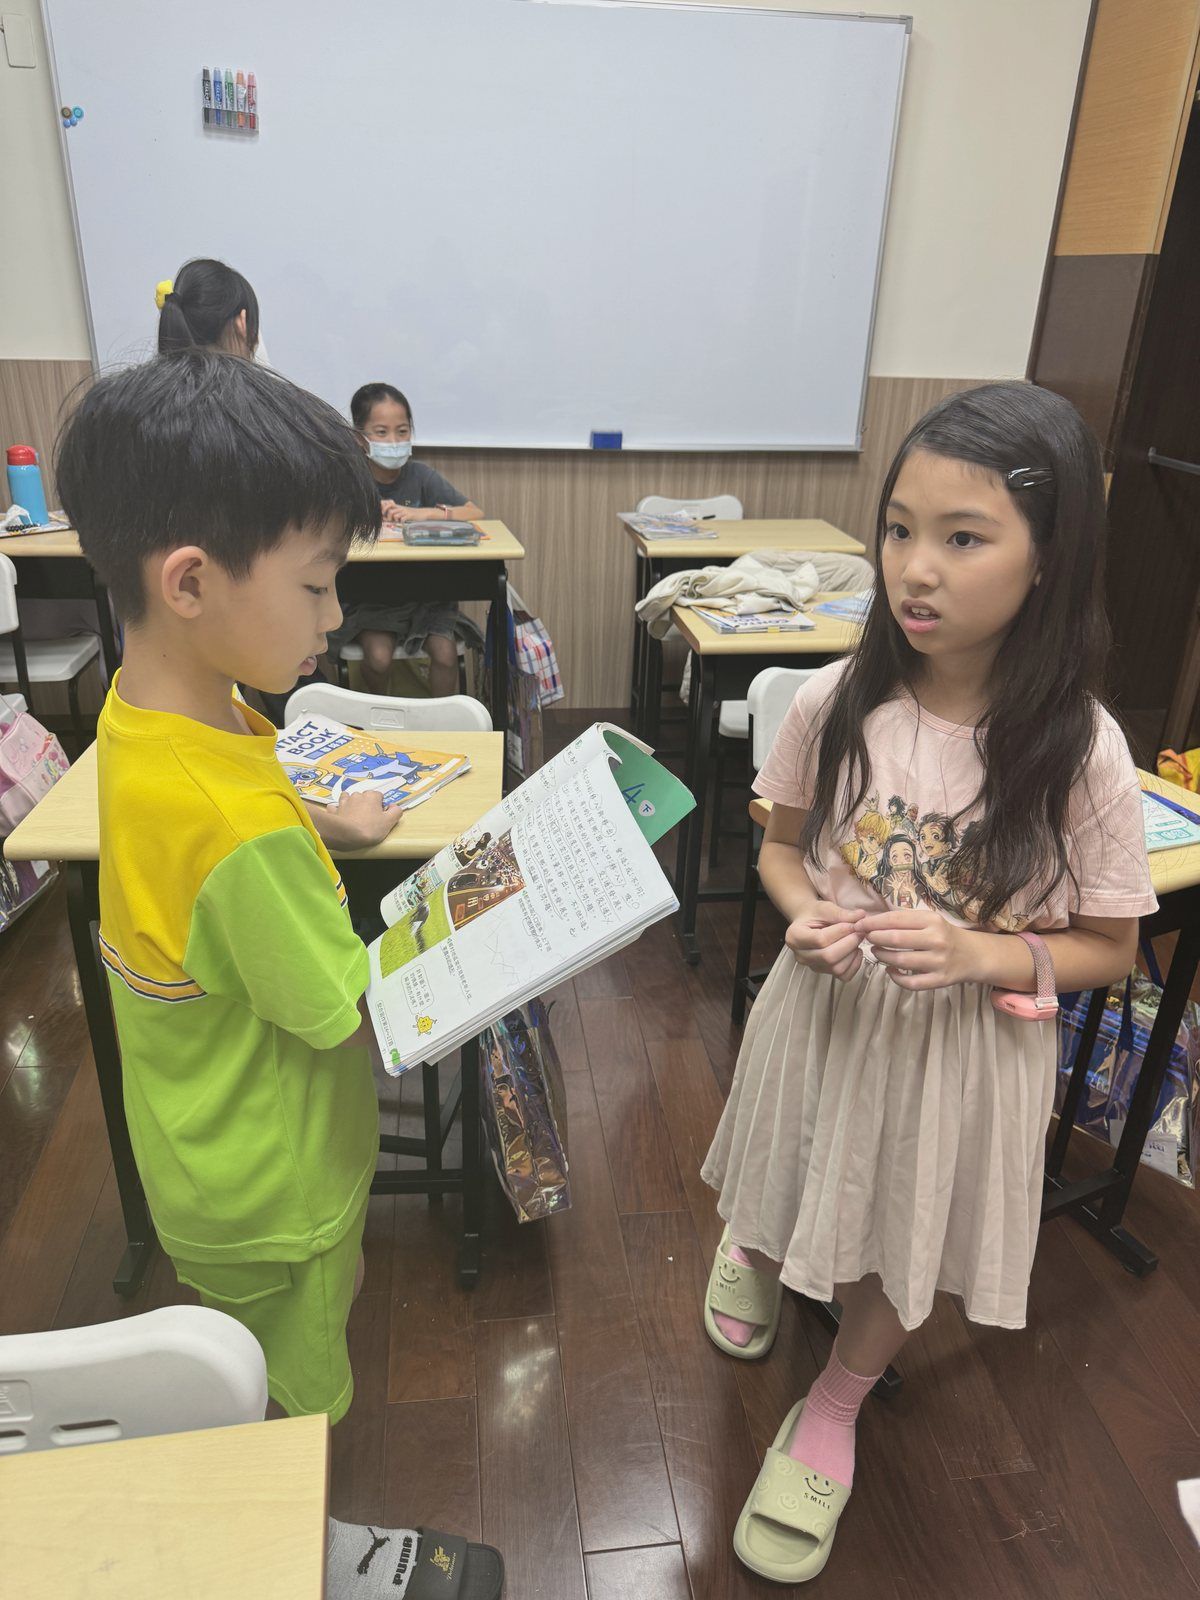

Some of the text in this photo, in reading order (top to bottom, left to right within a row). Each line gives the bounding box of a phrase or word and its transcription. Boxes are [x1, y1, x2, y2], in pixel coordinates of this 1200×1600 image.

[286, 728, 337, 755] BOOK
[621, 782, 653, 813] 4 下
[392, 1535, 413, 1585] PUMA
